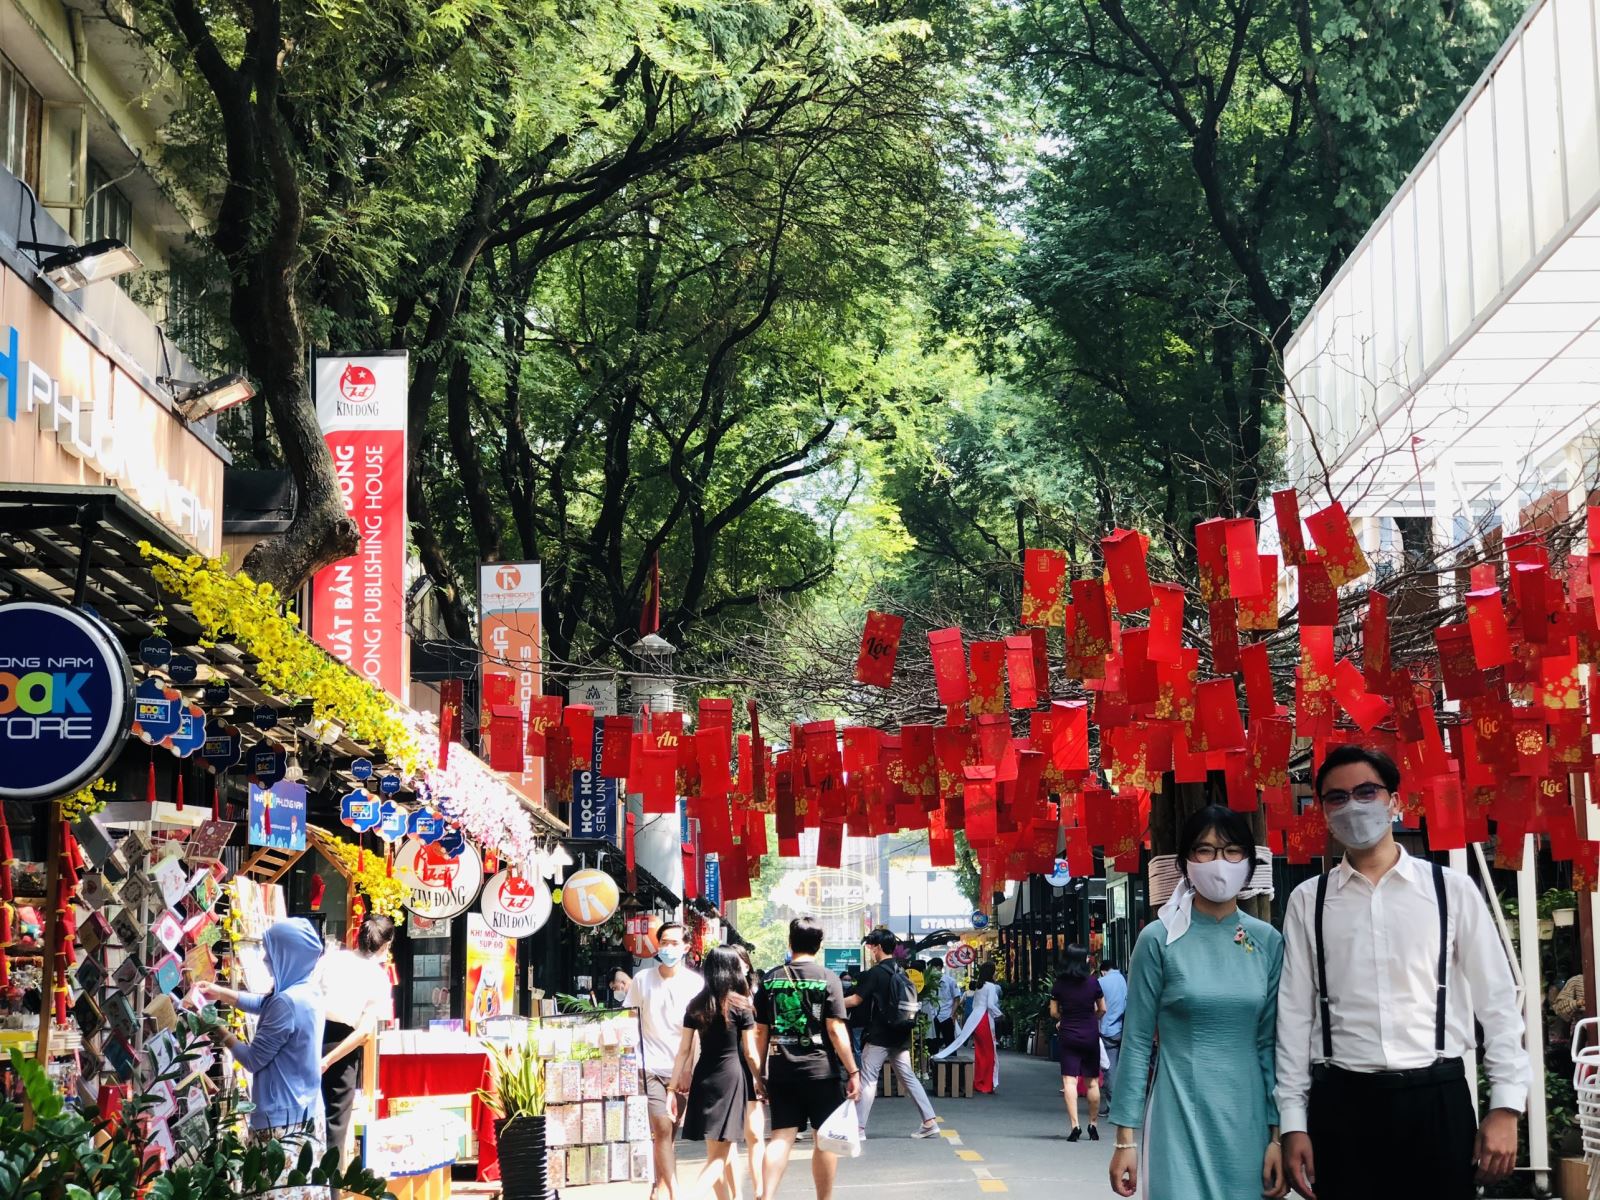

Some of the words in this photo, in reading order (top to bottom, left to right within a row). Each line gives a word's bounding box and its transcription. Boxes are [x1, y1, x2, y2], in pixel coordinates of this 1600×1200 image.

[336, 401, 354, 416] KIM
[365, 445, 382, 509] HOUSE
[364, 516, 382, 623] PUBLISHING
[328, 616, 352, 666] UẤT
[48, 657, 93, 667] NAM
[140, 704, 166, 714] BOOK
[0, 717, 92, 739] ORE
[656, 731, 679, 748] An
[581, 799, 596, 833] HỌC
[595, 808, 606, 832] SEN
[493, 911, 510, 928] KIM
[763, 979, 828, 991] VENOM
